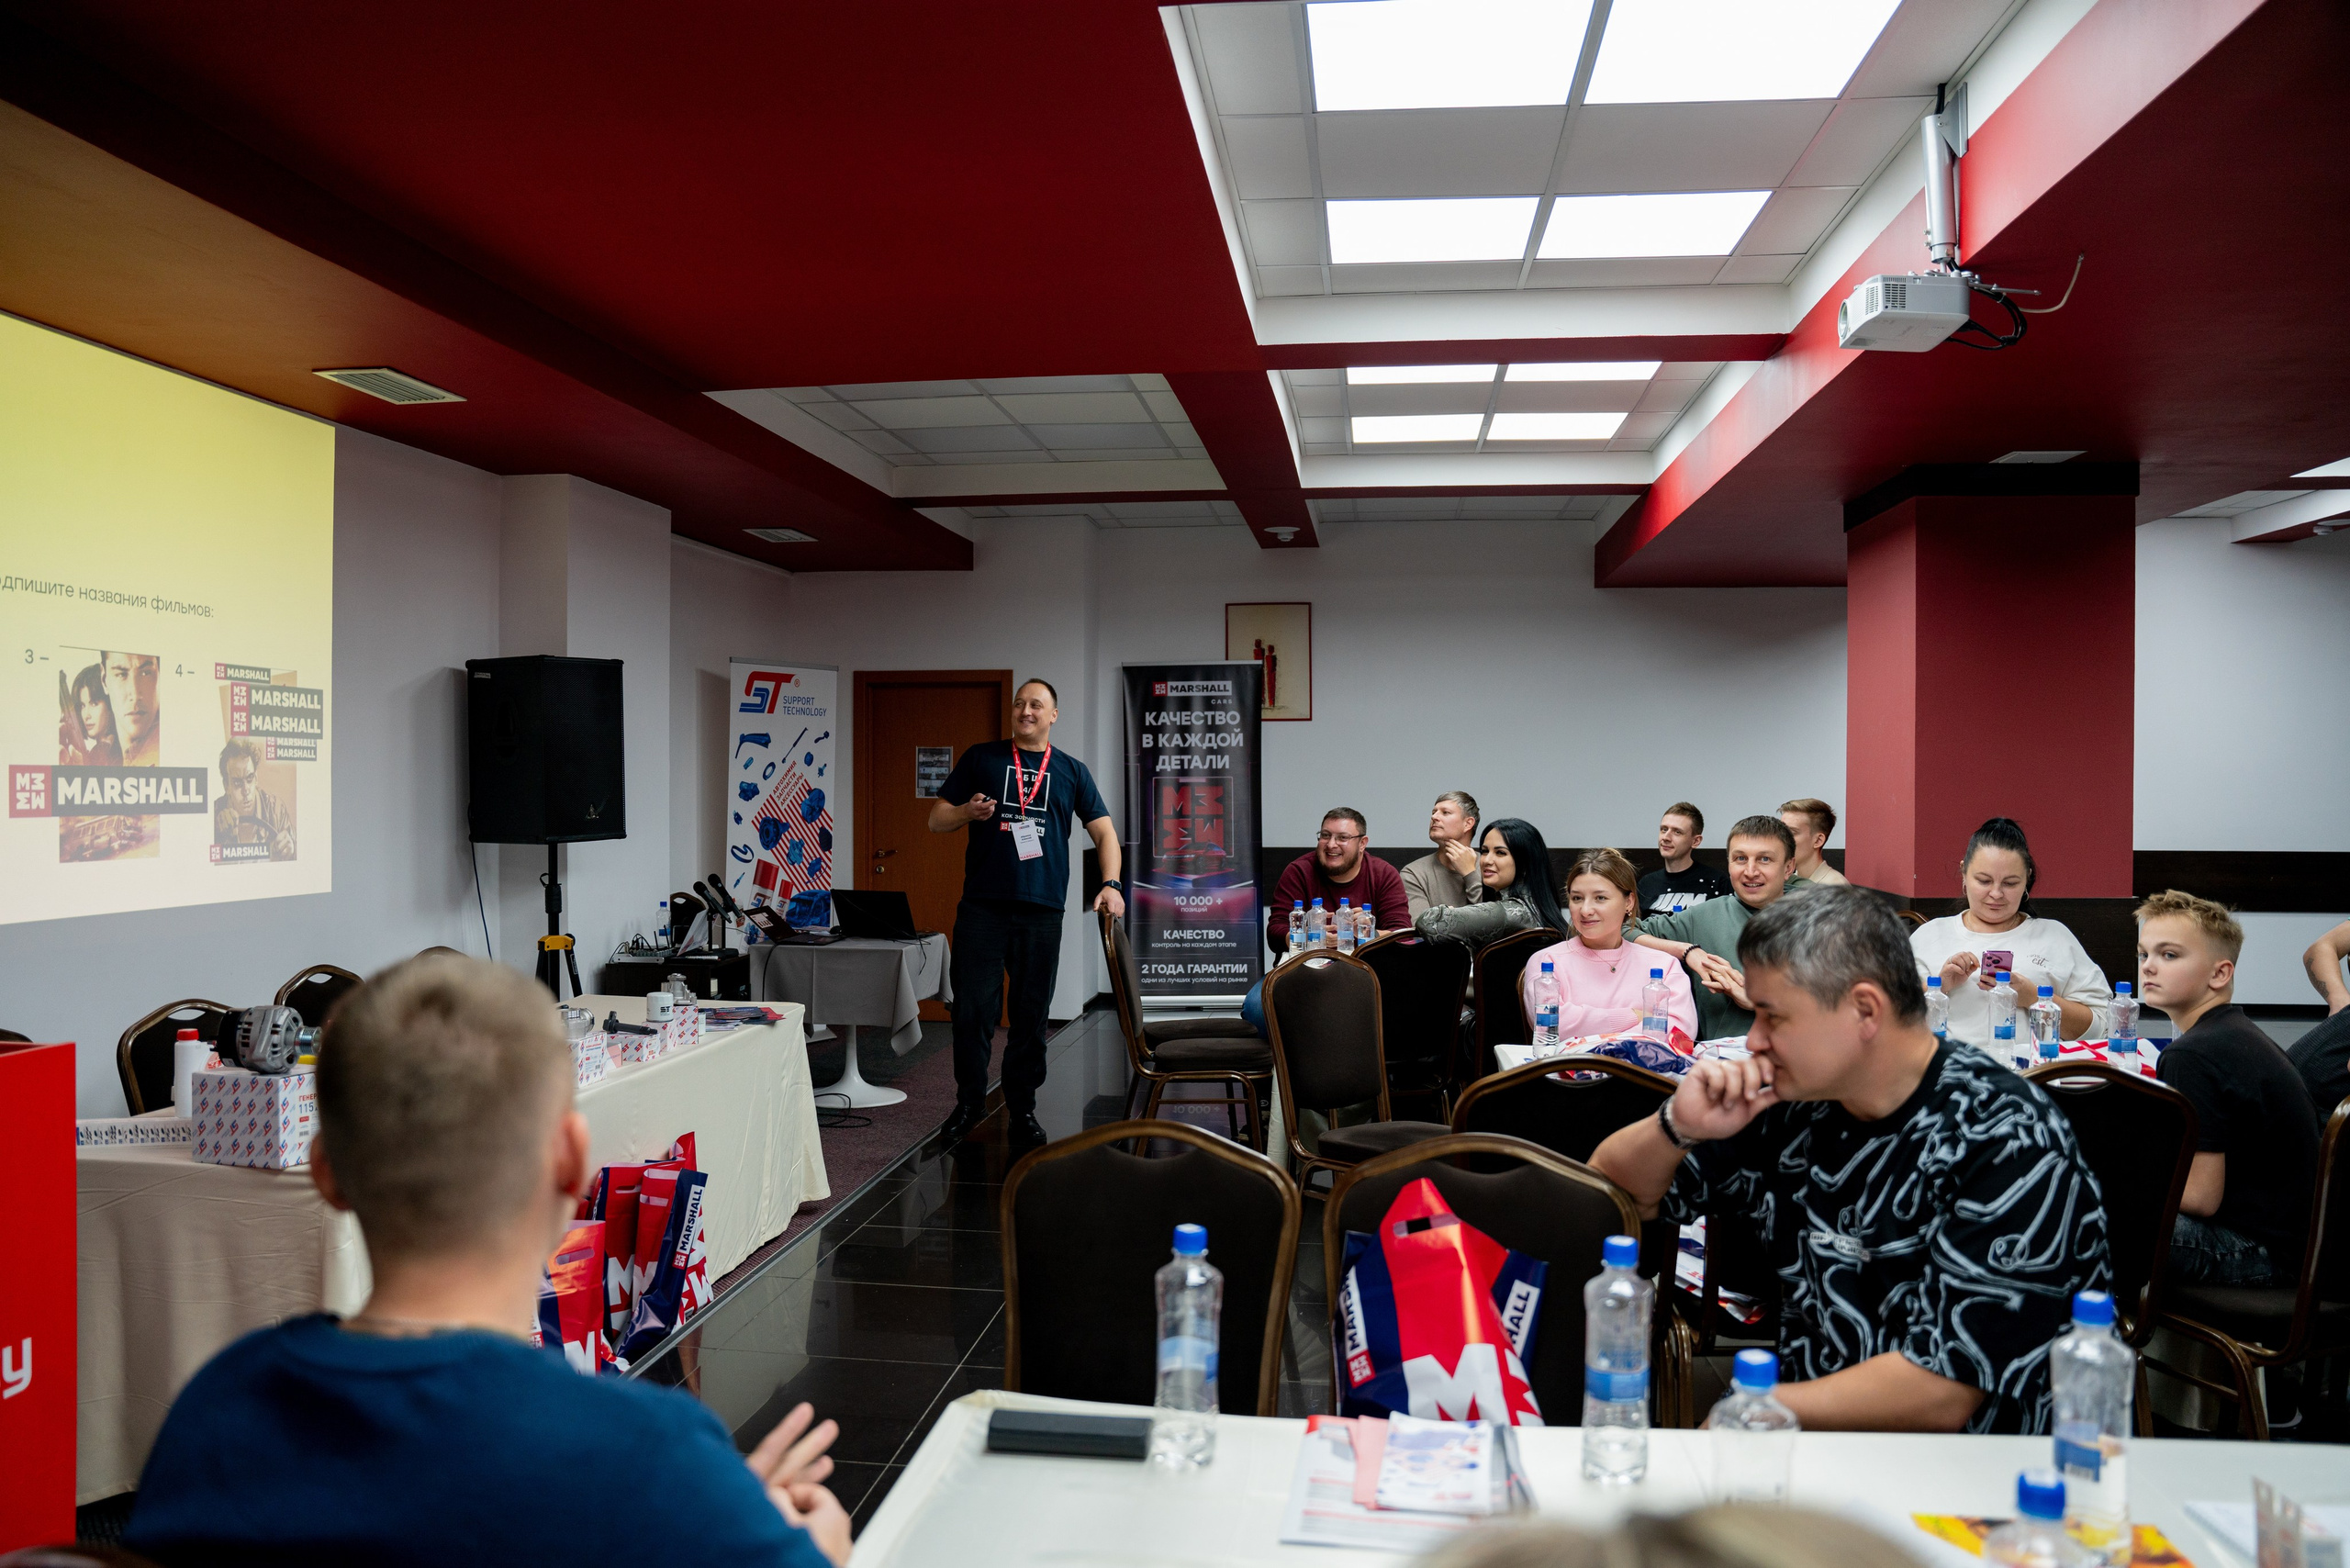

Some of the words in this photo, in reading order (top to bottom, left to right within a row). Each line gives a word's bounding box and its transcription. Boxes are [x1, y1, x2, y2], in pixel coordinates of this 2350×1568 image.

[0, 576, 74, 598] дпишите
[79, 587, 147, 609] названия
[151, 595, 214, 618] фильмов:
[25, 648, 34, 665] 3
[175, 664, 183, 678] 4
[227, 667, 270, 681] MARSHALL
[1169, 684, 1229, 693] MARSHALL
[251, 689, 321, 710] MARSHALL
[783, 695, 815, 706] SUPPORT
[783, 706, 827, 717] TECHNOLOGY
[1145, 711, 1241, 726] КАЧЕСТВО
[251, 715, 321, 734] MARSHALL
[276, 737, 316, 747] MARSHALL
[1142, 733, 1154, 748] В
[1158, 728, 1244, 750] КАЖДОЙ
[276, 748, 316, 758] MARSHALL
[1156, 755, 1230, 772] ДЕТАЛИ
[772, 760, 797, 795] АВТОХИМИЯ
[57, 777, 204, 805] MARSHALL
[777, 771, 797, 801] ЗАПЧАСТИ
[780, 772, 804, 807] АКСЕССУАРЫ
[222, 846, 269, 858] MARSHALL
[1173, 896, 1187, 906] 10
[1189, 896, 1214, 906] 000
[1163, 929, 1225, 940] КАЧЕСТВО
[1141, 965, 1149, 974] 2
[1151, 964, 1185, 975] ГОДА
[1187, 964, 1248, 974] ГАРАНТИИ
[1192, 976, 1218, 984] условий
[679, 1189, 702, 1251] MARSHALL
